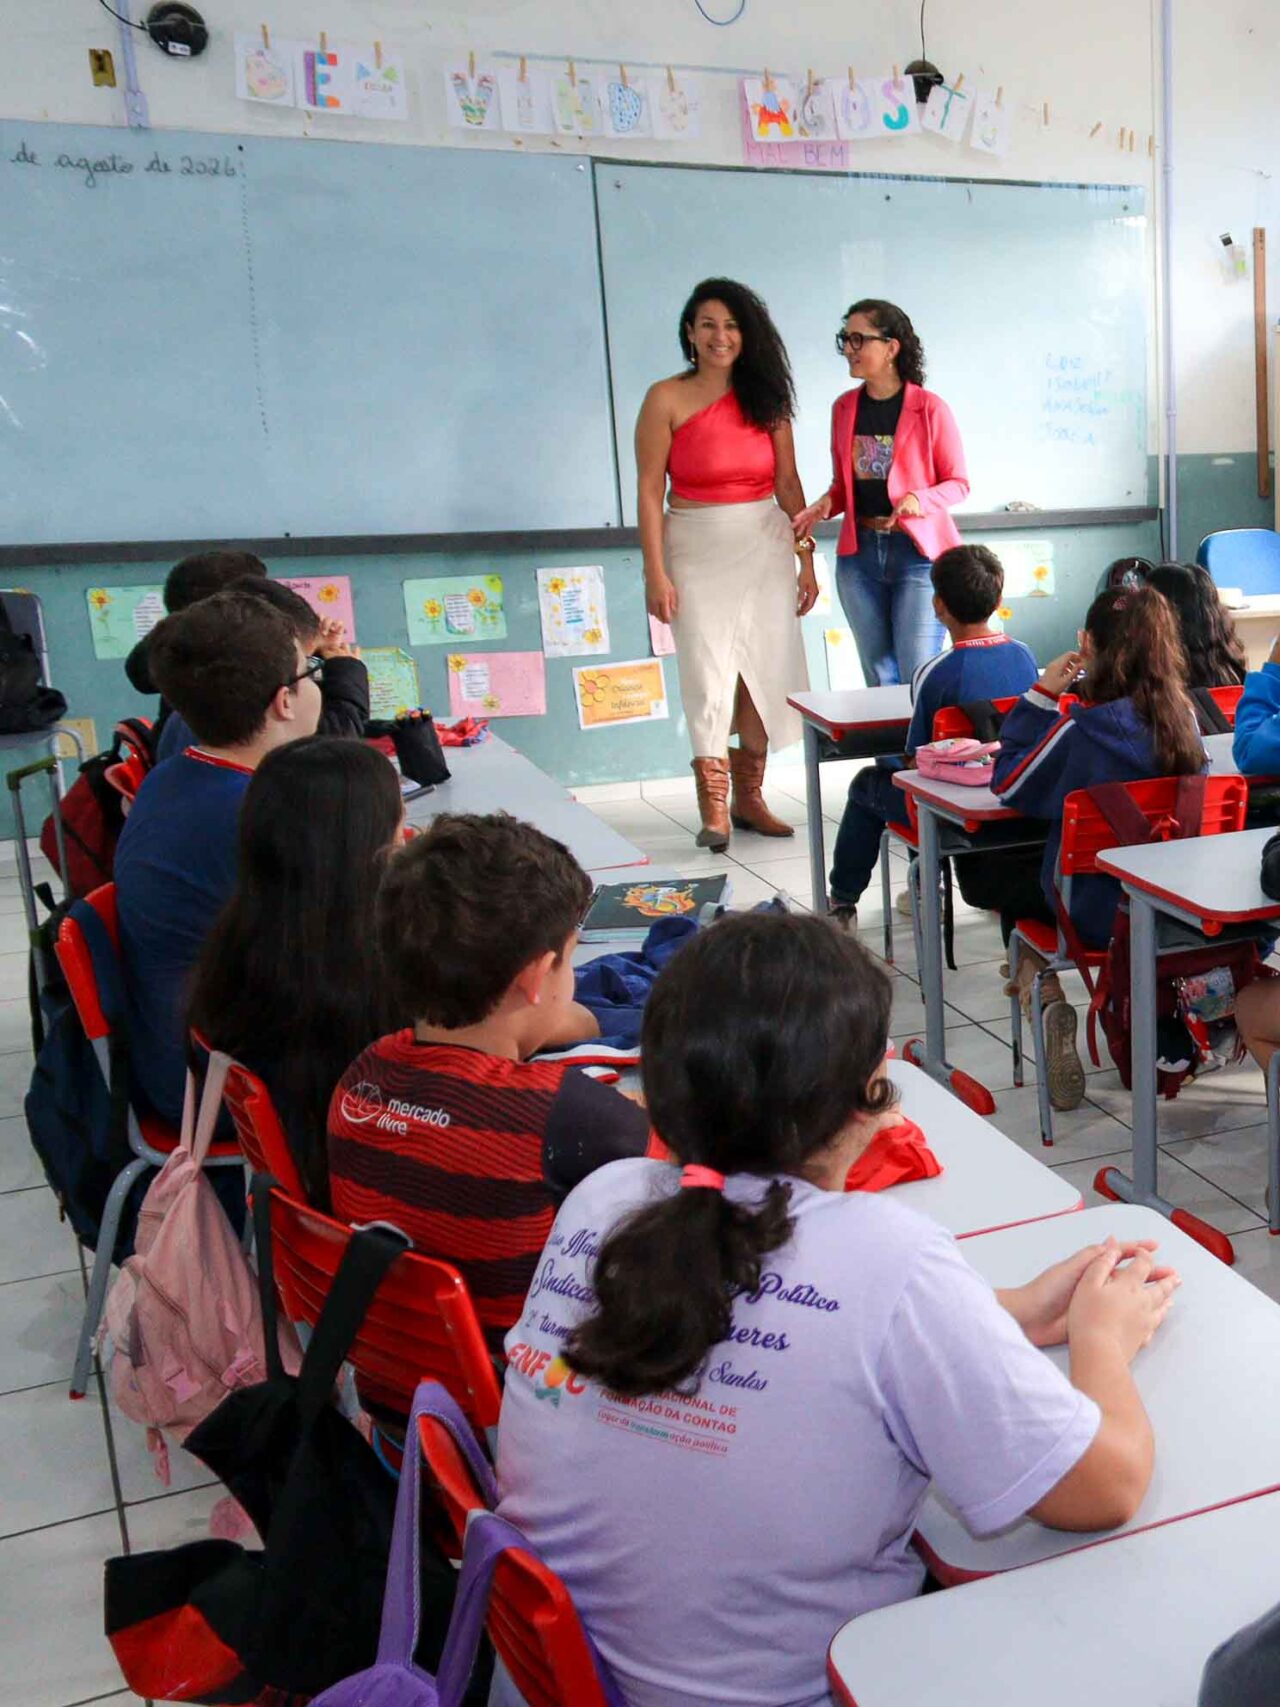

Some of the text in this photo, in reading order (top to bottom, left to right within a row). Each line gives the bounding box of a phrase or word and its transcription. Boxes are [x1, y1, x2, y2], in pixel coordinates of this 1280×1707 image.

[10, 141, 237, 188] de agosto de 2026
[376, 1112, 408, 1136] livre
[386, 1098, 451, 1129] mercado
[708, 1361, 769, 1391] Santos
[663, 1406, 681, 1421] DA
[682, 1412, 737, 1435] CONTAG
[718, 1404, 737, 1418] DE
